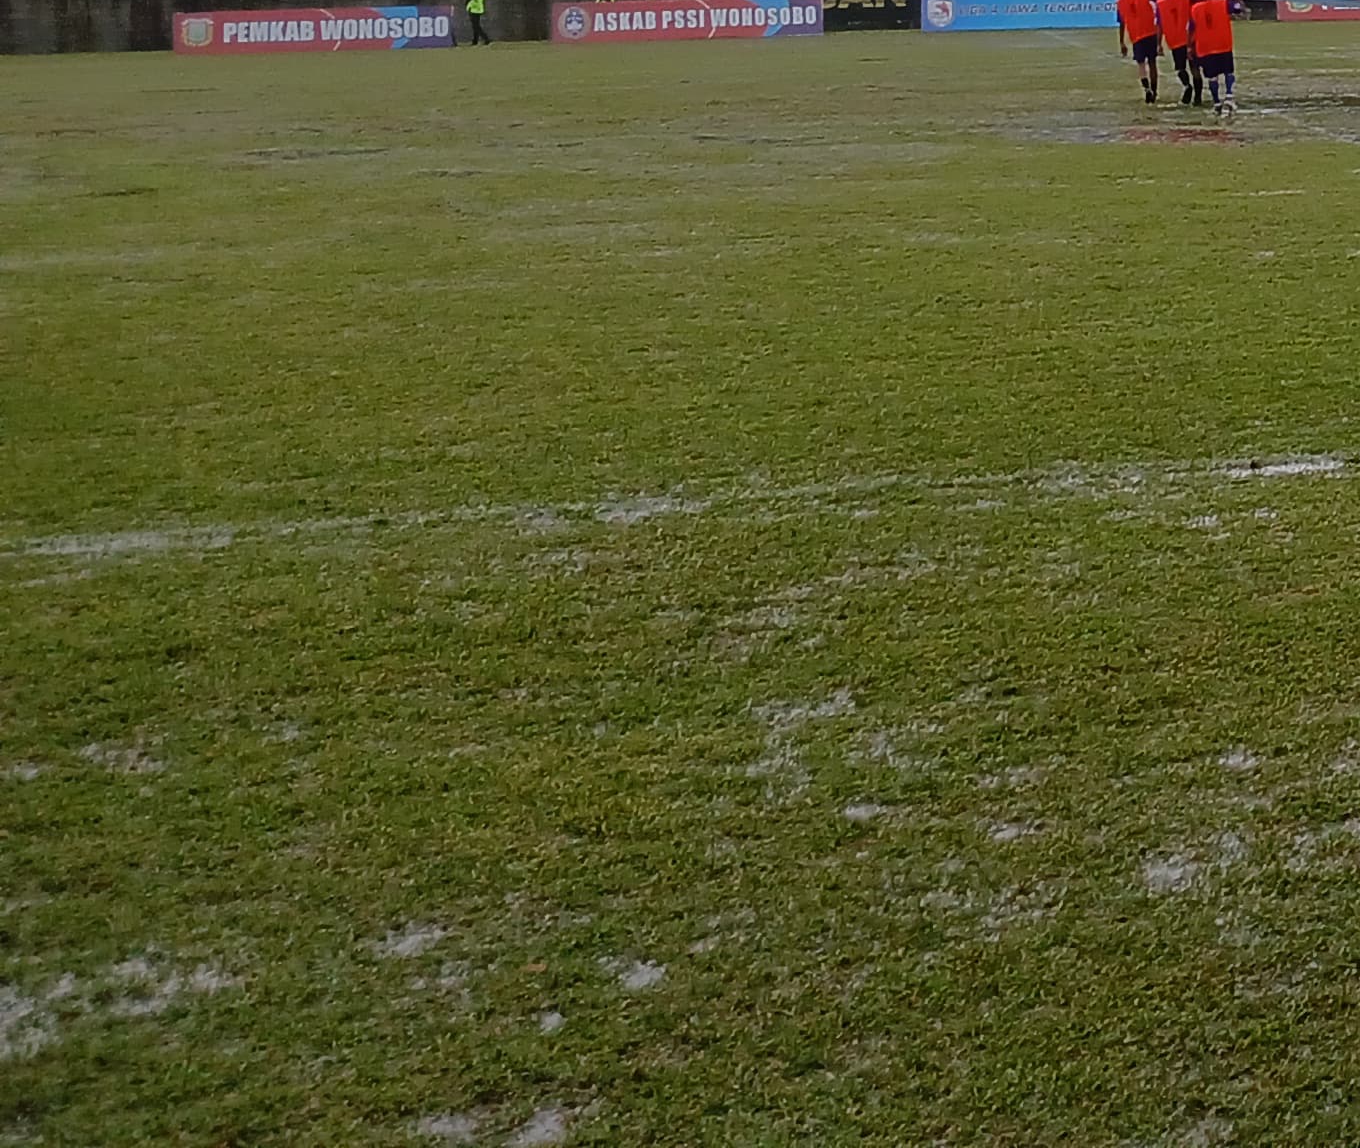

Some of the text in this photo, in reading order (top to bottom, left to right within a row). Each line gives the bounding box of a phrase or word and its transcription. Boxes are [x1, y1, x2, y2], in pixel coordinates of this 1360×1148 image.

[594, 5, 817, 32] ASKAB PSSI WONOSOBO
[1044, 2, 1092, 13] TENGAH
[223, 15, 449, 44] PEMKAB WONOSOBO
